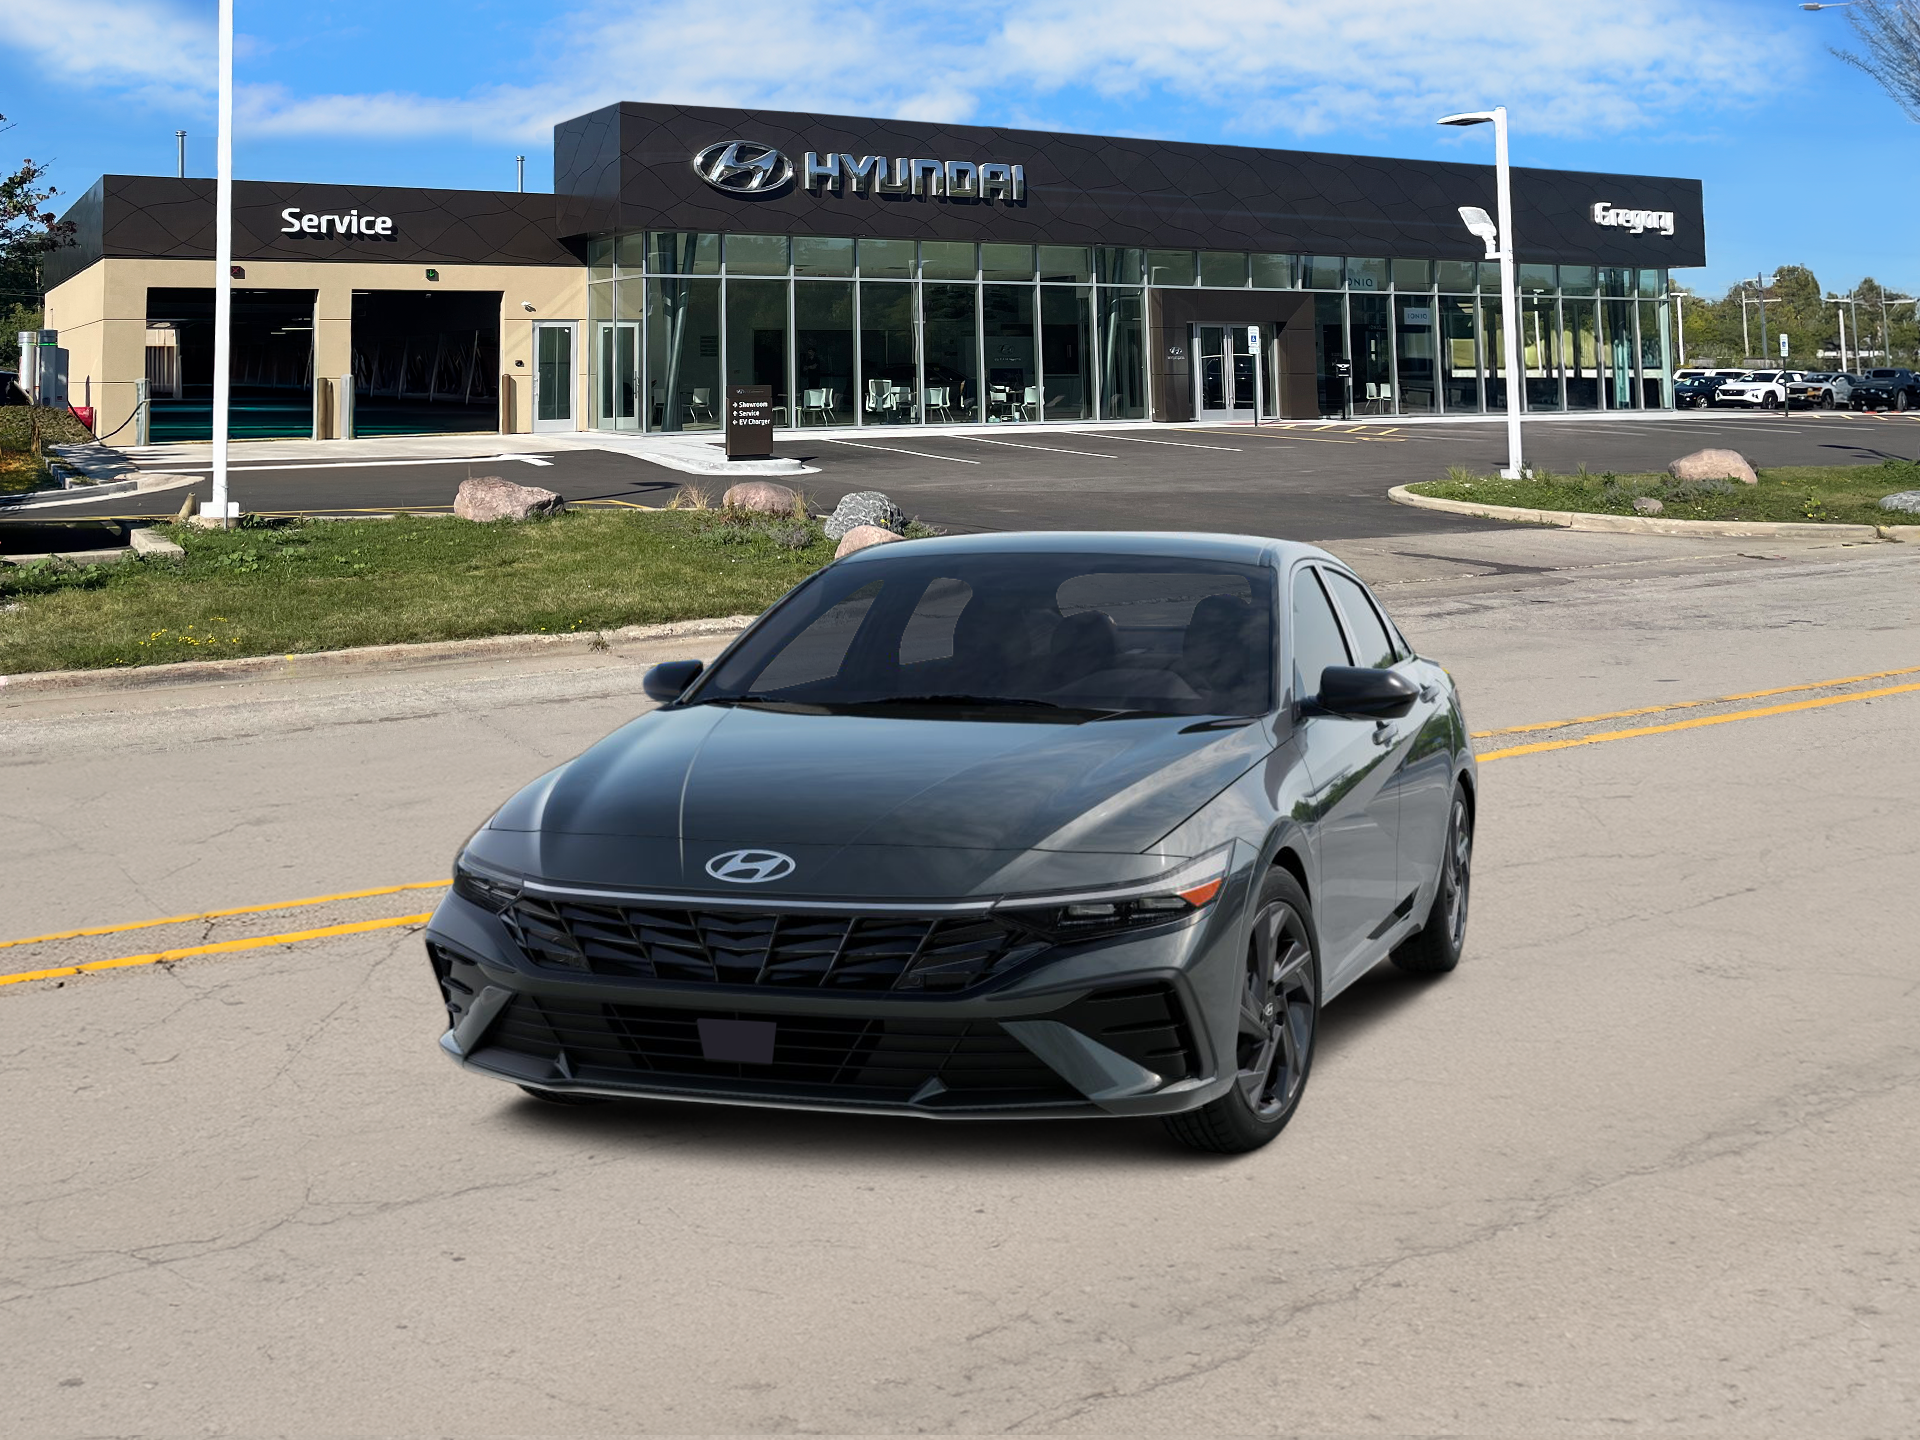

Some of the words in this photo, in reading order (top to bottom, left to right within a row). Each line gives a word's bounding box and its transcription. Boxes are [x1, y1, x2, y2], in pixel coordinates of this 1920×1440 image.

[804, 151, 1024, 200] HYUNDAI
[281, 207, 393, 235] Service
[1593, 202, 1674, 236] Gregory
[1347, 277, 1373, 287] ONIQ
